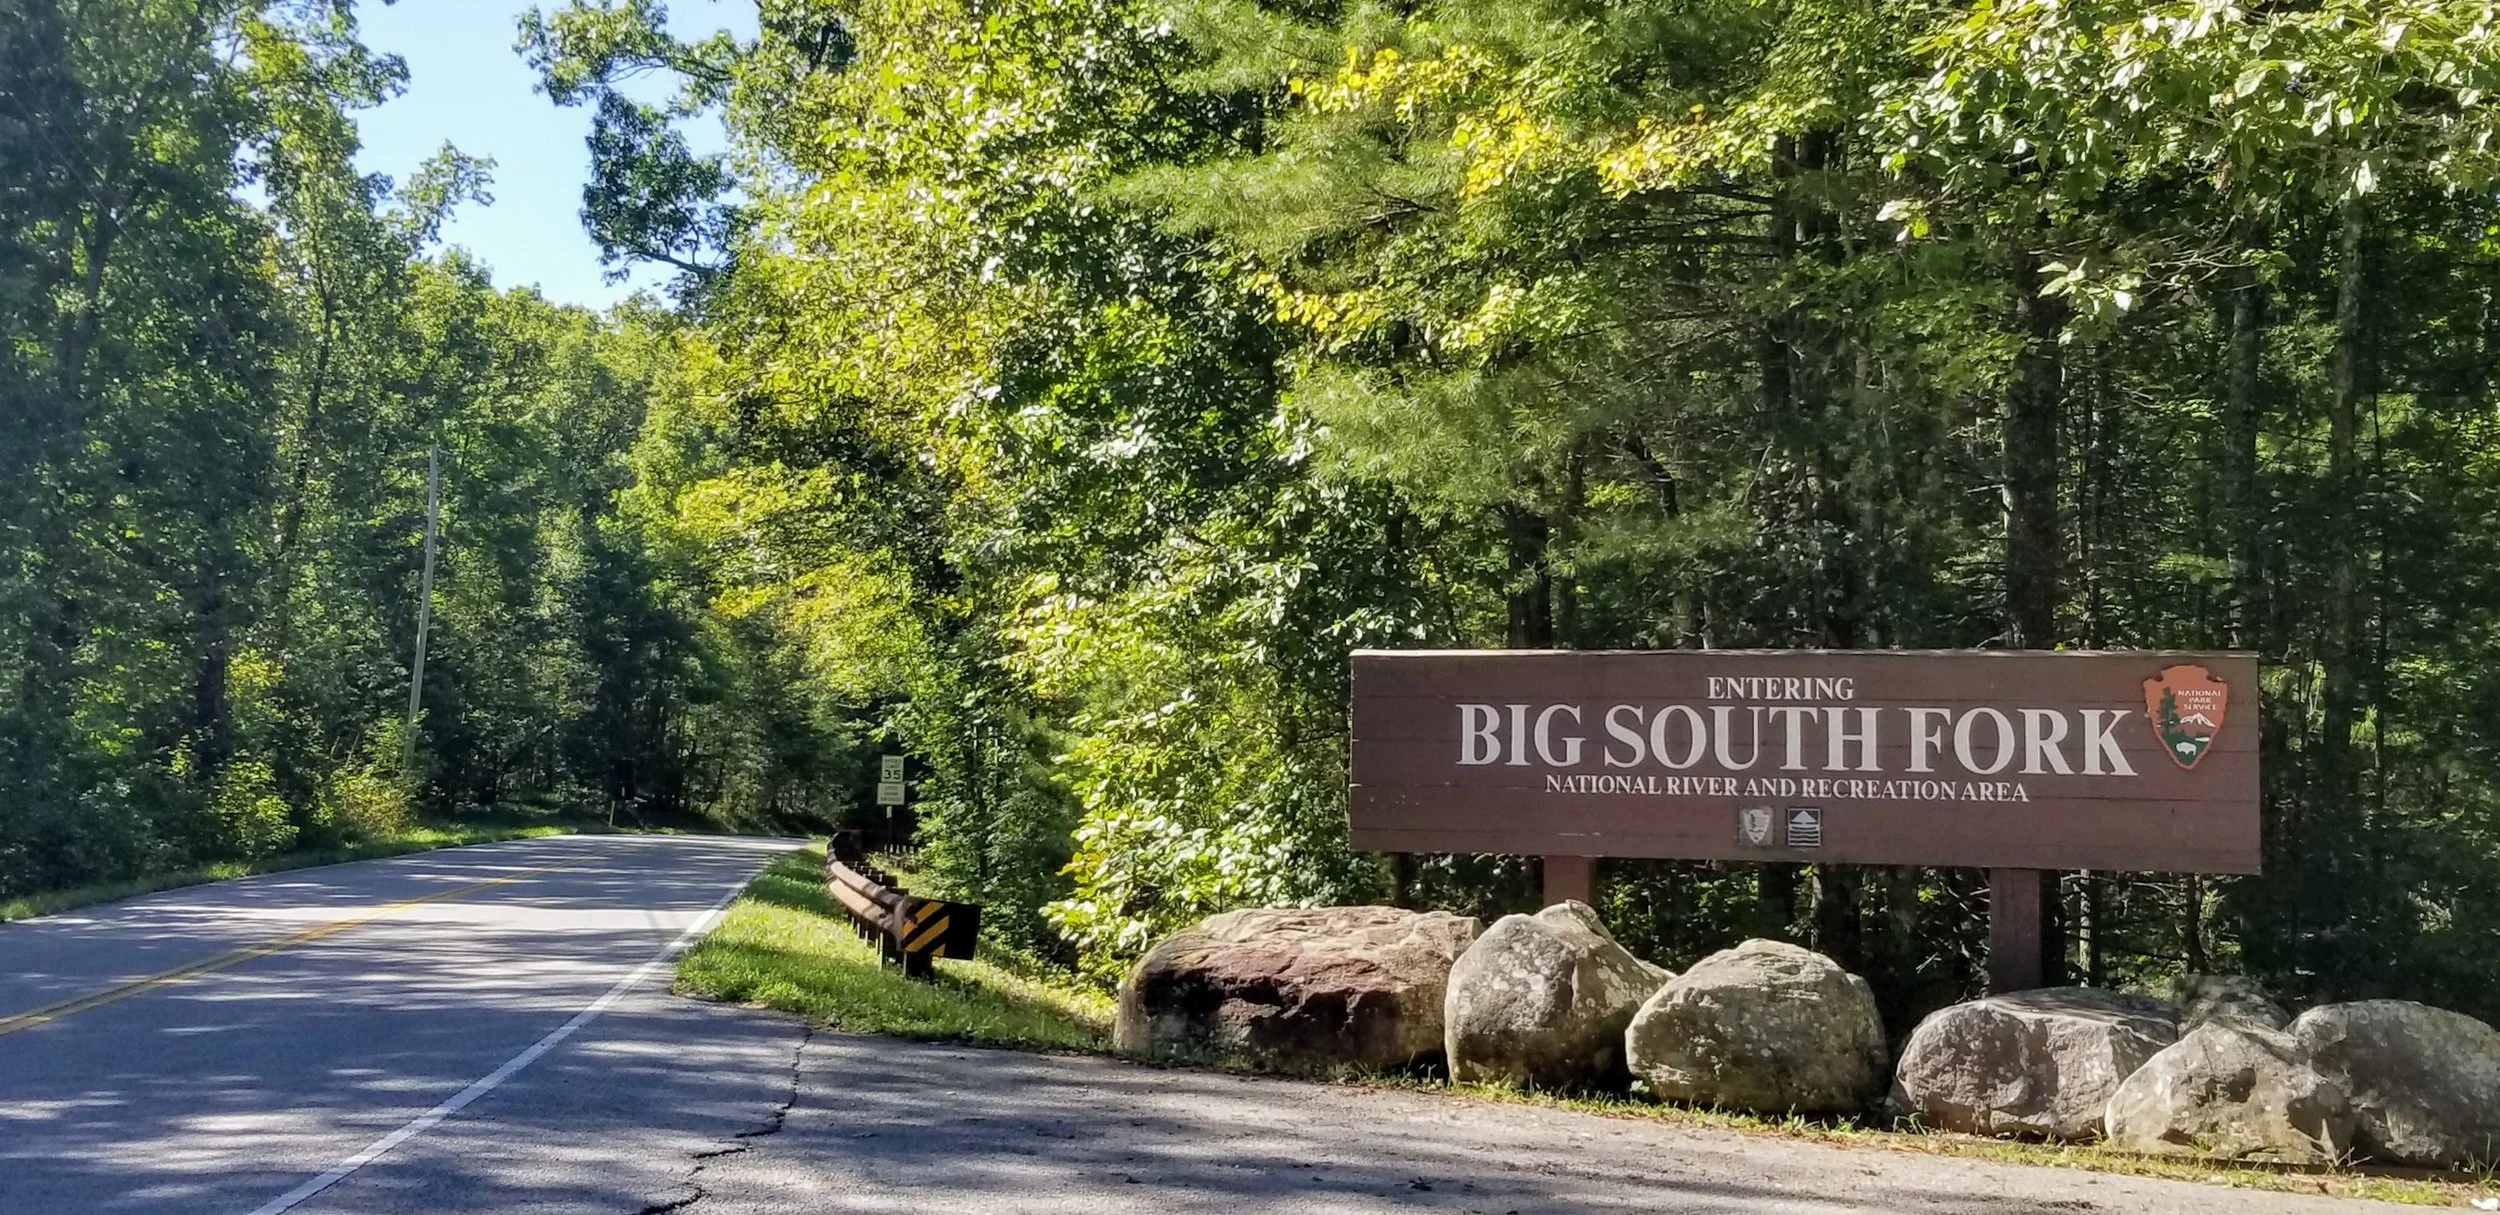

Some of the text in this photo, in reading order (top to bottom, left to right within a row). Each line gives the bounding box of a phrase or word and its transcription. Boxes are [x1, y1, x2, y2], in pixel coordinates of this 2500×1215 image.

[1707, 677, 1854, 700] ENTERING
[1456, 704, 2138, 776] BIG SOUTH FORK
[884, 769, 901, 780] 35
[1546, 774, 2030, 802] NATIONAL RIVER AND RECREATION AREA
